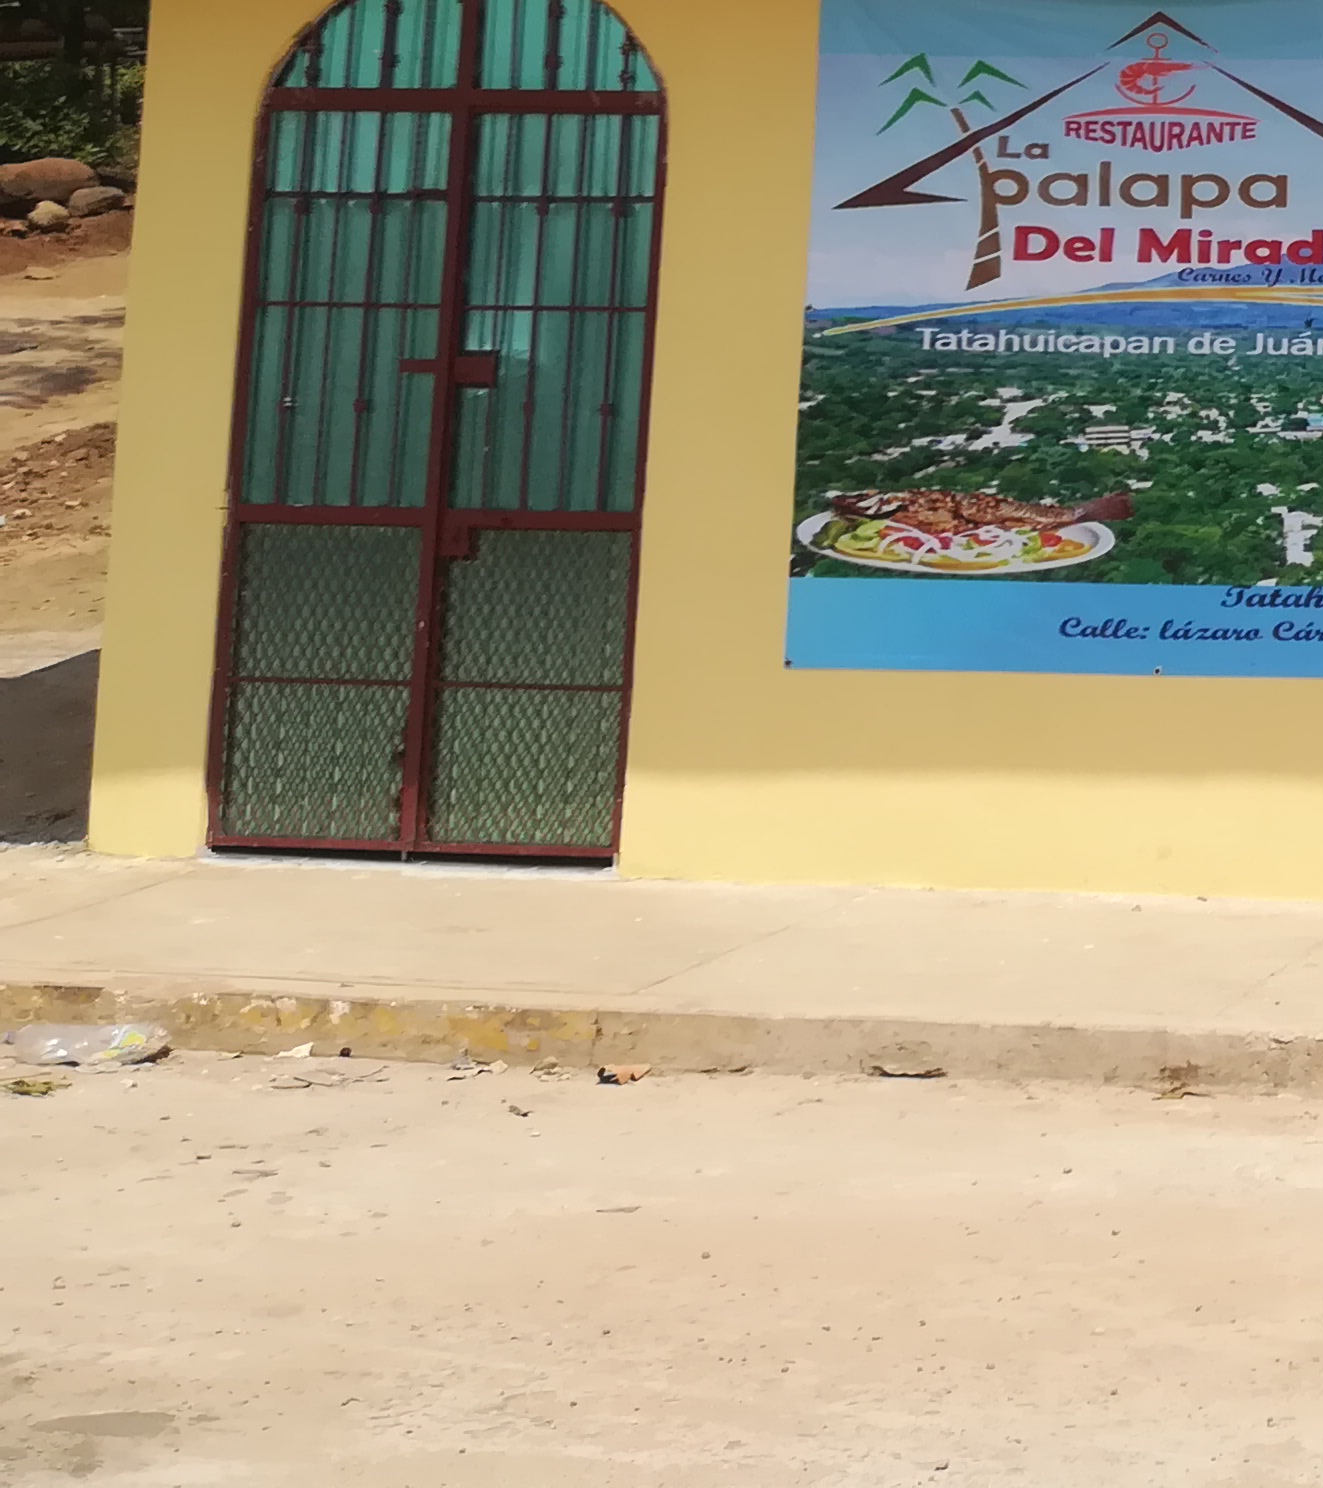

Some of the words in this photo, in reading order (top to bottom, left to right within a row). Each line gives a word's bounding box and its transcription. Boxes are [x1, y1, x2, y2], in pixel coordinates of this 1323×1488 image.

[997, 135, 1050, 160] La
[1063, 118, 1258, 153] RESTAURANTE
[982, 161, 1289, 219] palapa
[1012, 225, 1115, 263] Del
[1177, 267, 1252, 284] Carnes
[915, 327, 1175, 358] Tatahuicapan
[1187, 332, 1237, 355] de
[1058, 617, 1150, 640] Calle:
[1158, 619, 1264, 642] lázaro
